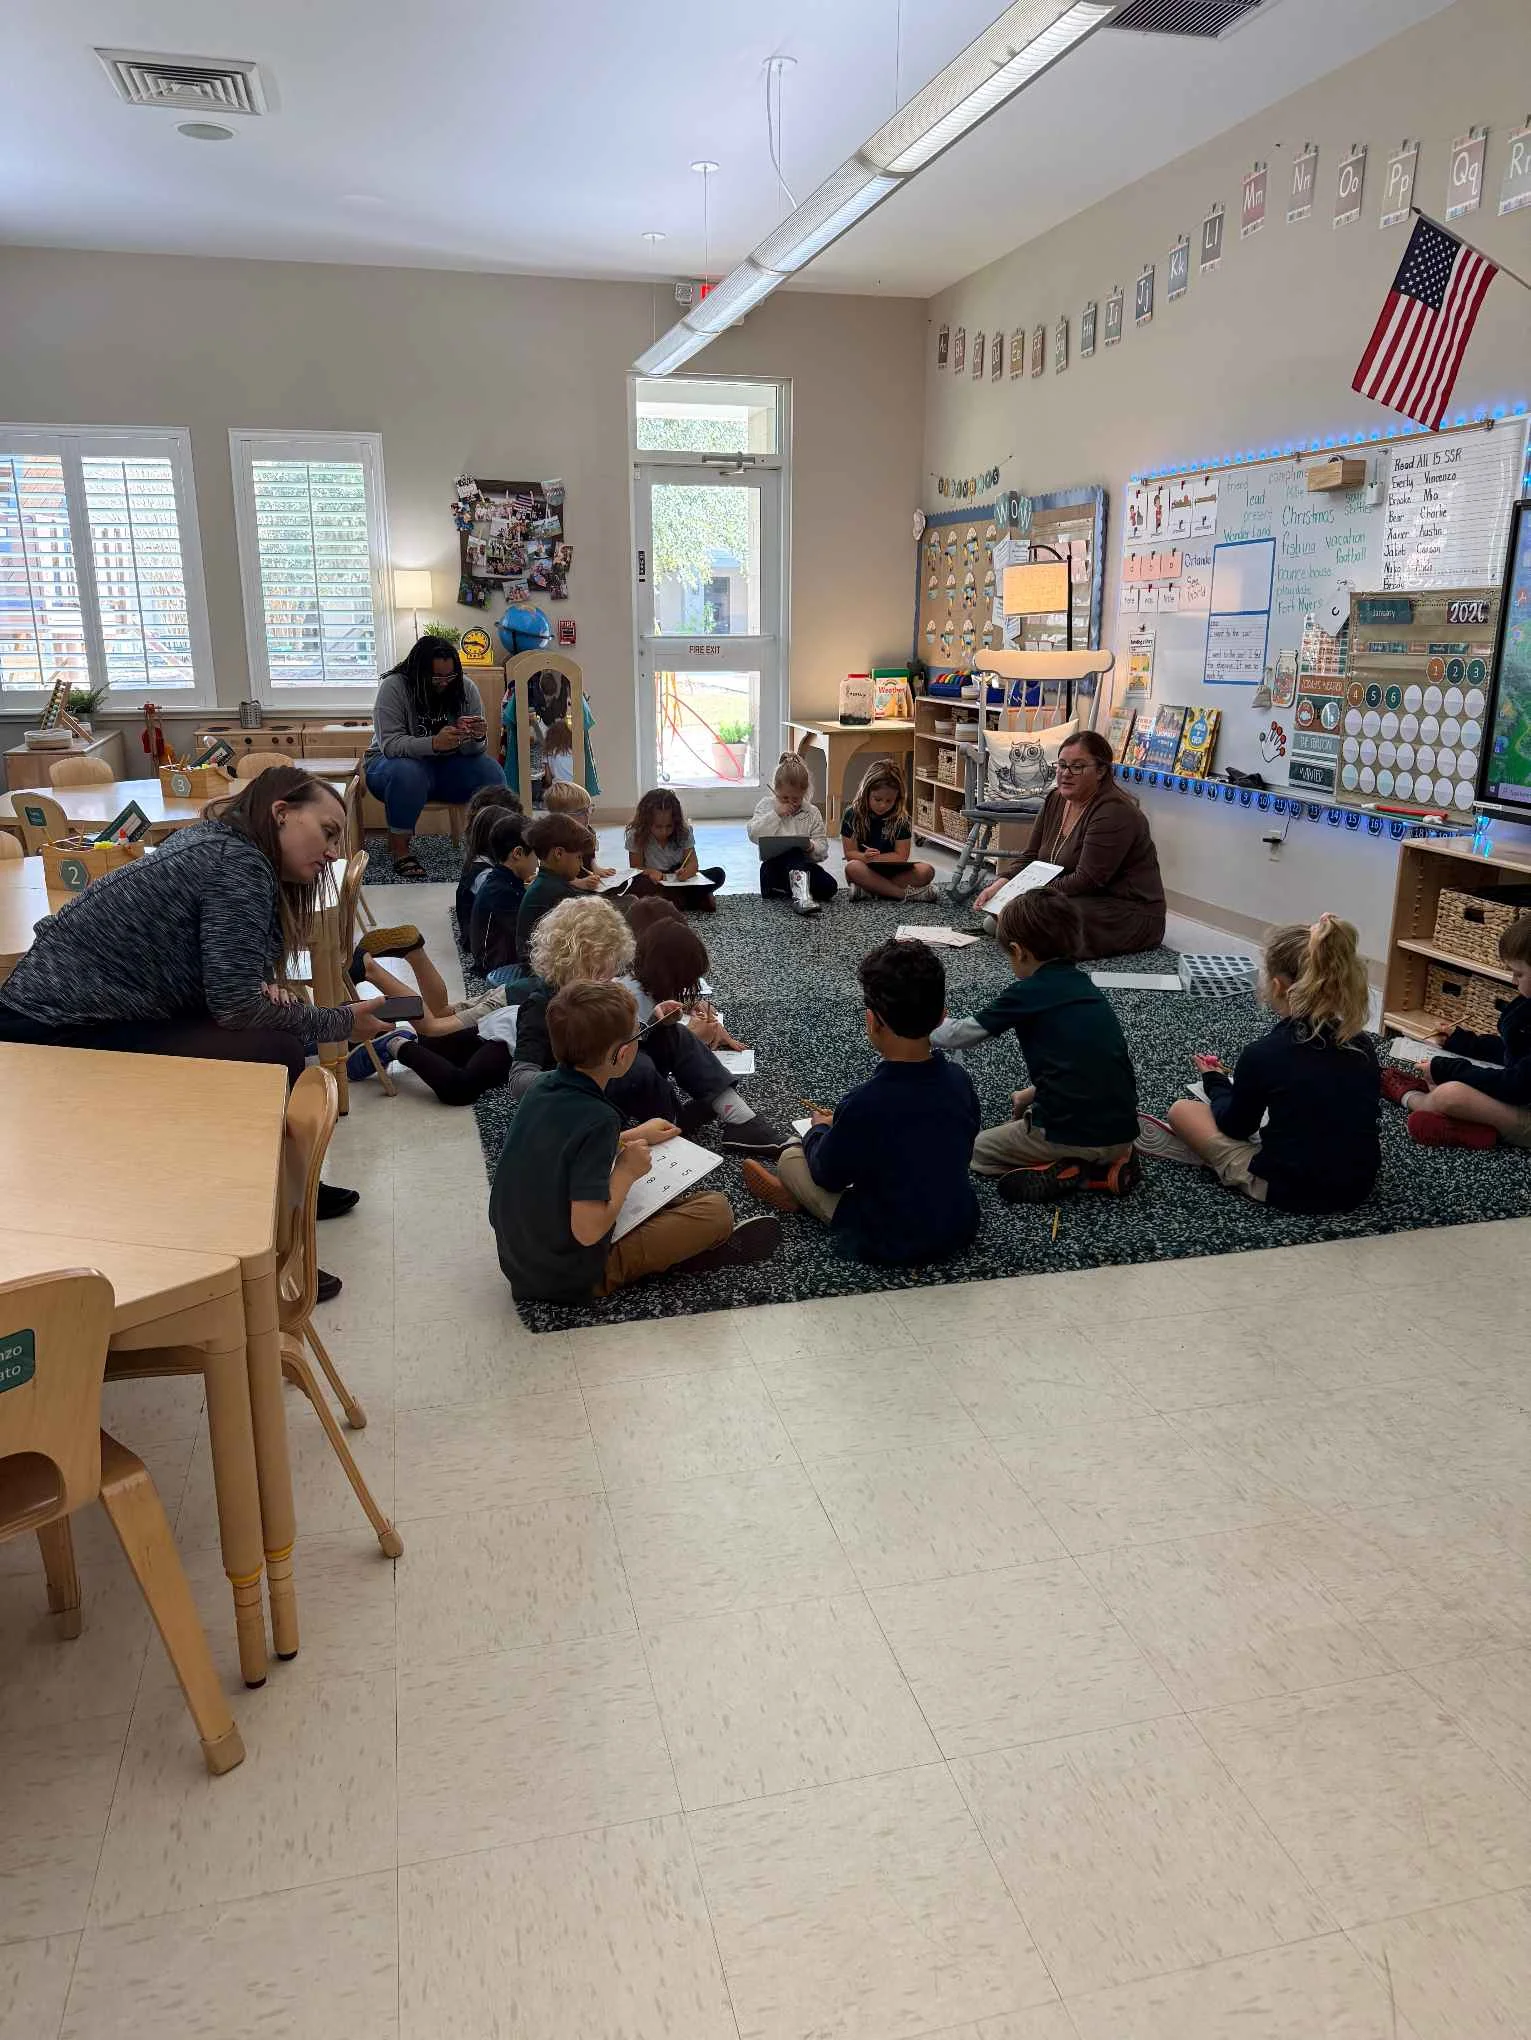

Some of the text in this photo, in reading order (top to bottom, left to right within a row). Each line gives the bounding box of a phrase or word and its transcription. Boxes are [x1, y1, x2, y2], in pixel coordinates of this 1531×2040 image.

[1292, 166, 1311, 195] Nn
[1339, 166, 1360, 197] Oo
[1453, 151, 1479, 196] Qq
[1388, 163, 1410, 208] Pp
[1243, 186, 1263, 212] Mm
[1205, 219, 1220, 249] Ll
[1170, 251, 1184, 280] Kk
[1137, 280, 1149, 312] Jj
[1416, 453, 1429, 469] All
[1433, 452, 1441, 466] 15
[1282, 504, 1335, 527] Christmas
[1325, 527, 1366, 547] vacation
[1372, 609, 1396, 618] January
[1449, 602, 1485, 623] 2026
[689, 645, 721, 654] FIRE EXIT
[1453, 666, 1458, 677] 2
[1472, 666, 1479, 678] 3
[878, 686, 906, 695] Weather
[1352, 688, 1358, 699] 4
[177, 779, 185, 792] 3
[1259, 795, 1267, 805] 10
[1311, 805, 1318, 815] 13
[1330, 809, 1338, 819] 14
[1348, 813, 1356, 823] 15
[1371, 817, 1379, 828] 16
[1394, 822, 1402, 833] 17
[1416, 828, 1424, 838] 18
[67, 866, 81, 885] 2
